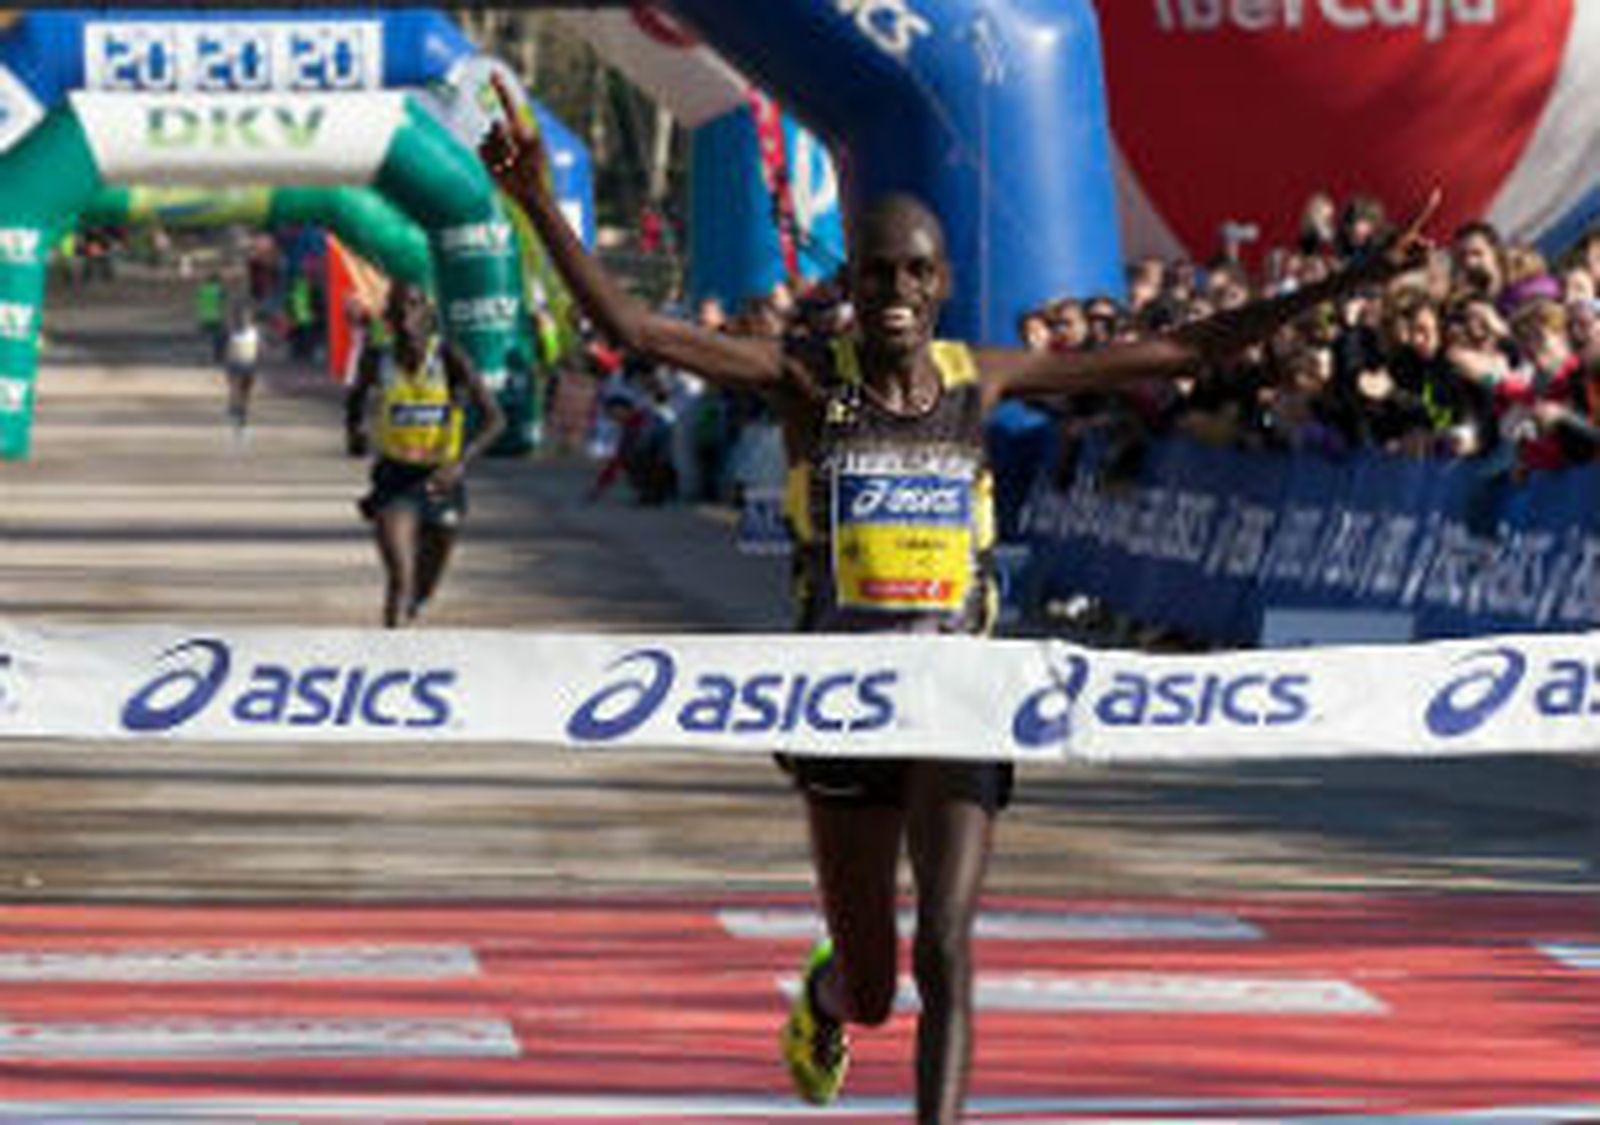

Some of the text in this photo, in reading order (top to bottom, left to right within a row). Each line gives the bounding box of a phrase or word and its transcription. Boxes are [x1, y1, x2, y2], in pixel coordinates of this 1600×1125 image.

[147, 106, 324, 147] DKV
[232, 664, 456, 728] asics
[677, 671, 898, 734] asics
[1095, 672, 1312, 726] asics
